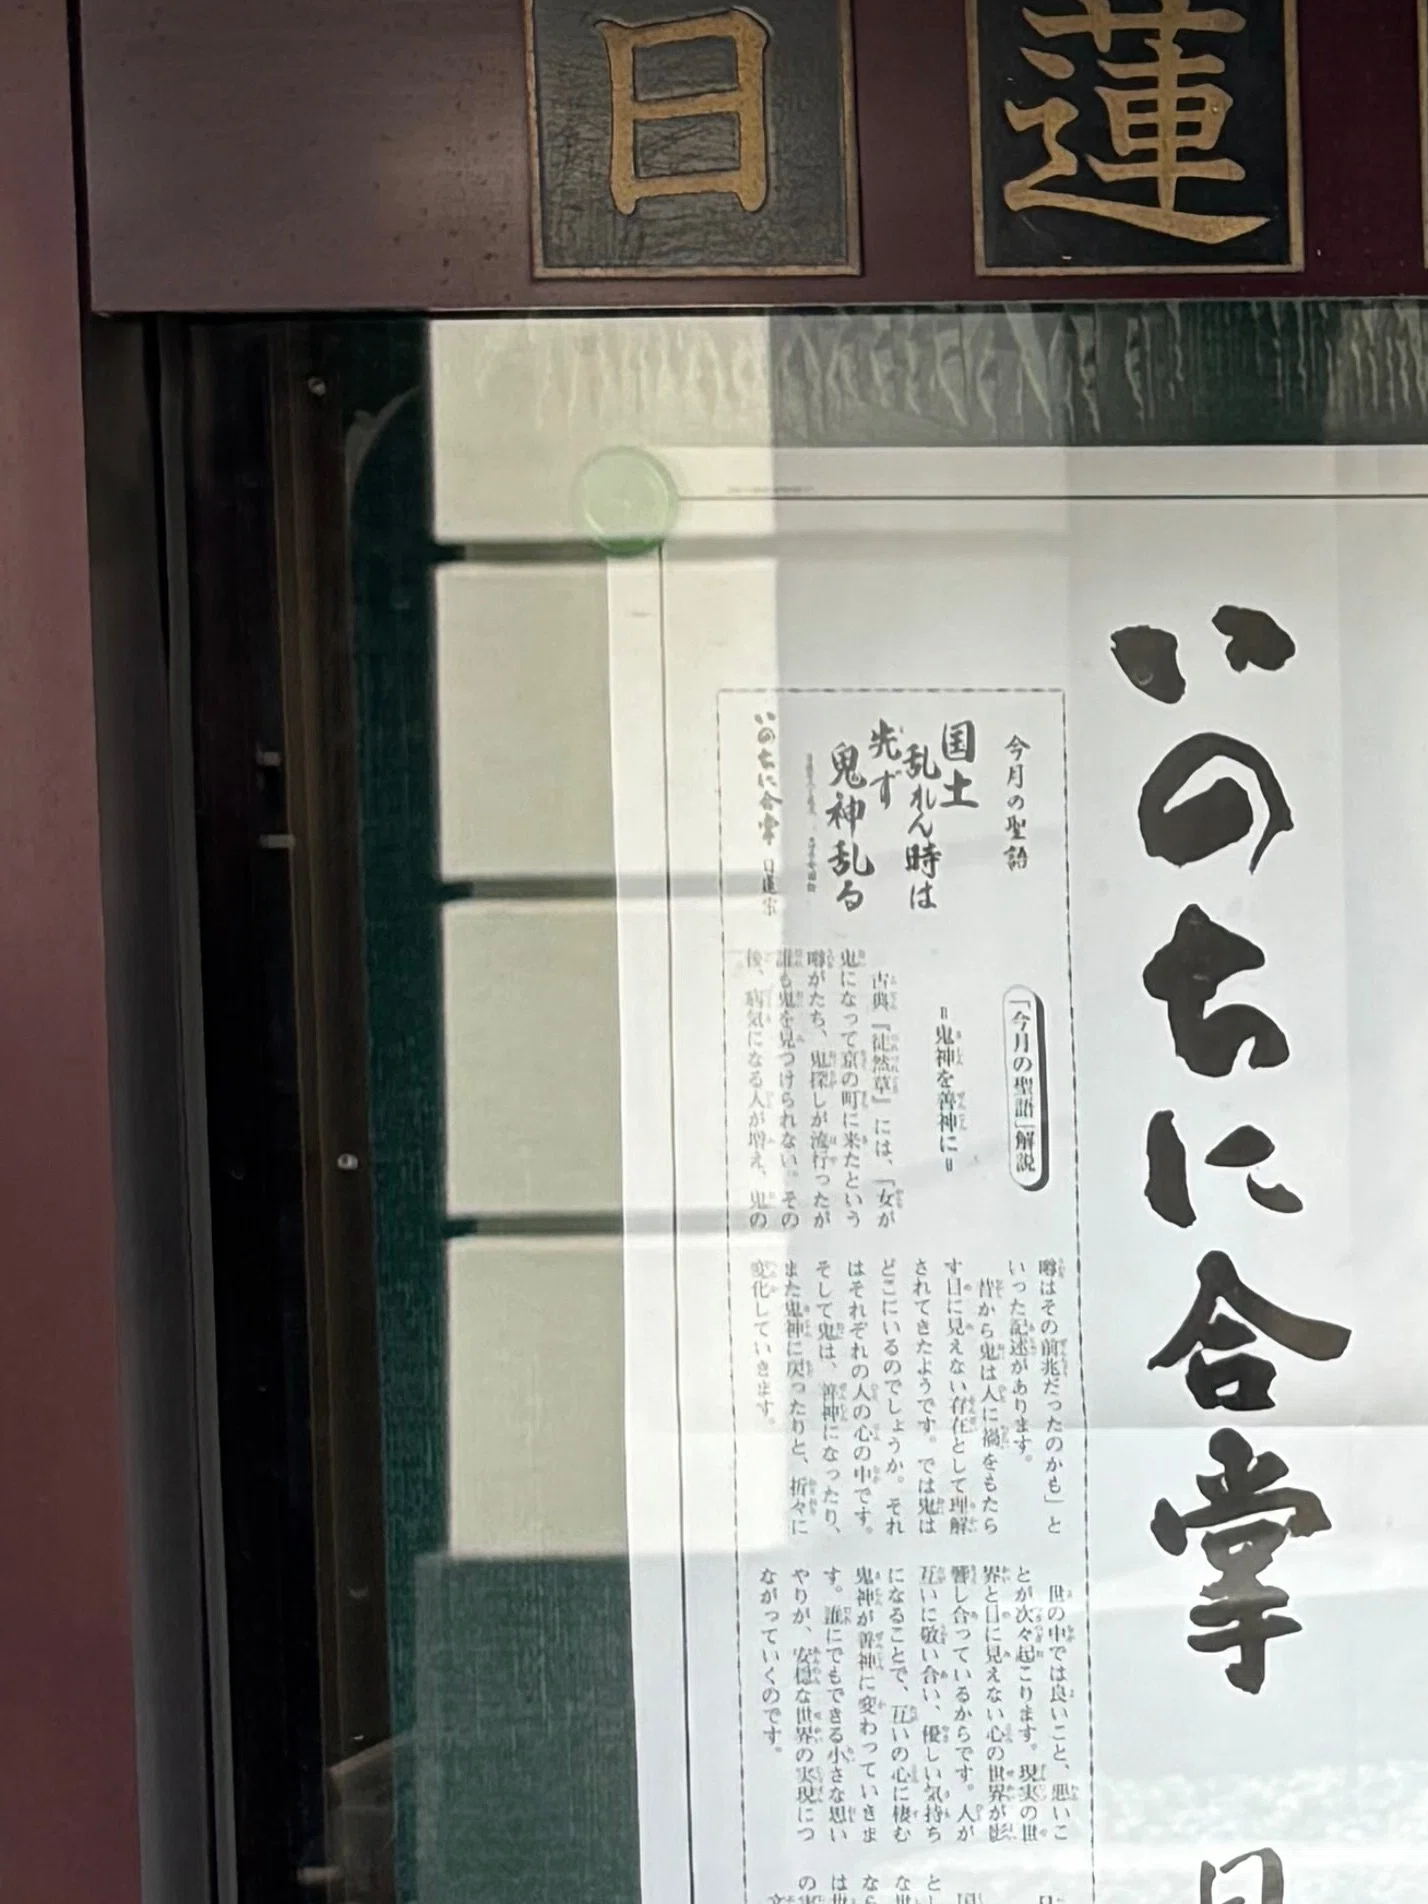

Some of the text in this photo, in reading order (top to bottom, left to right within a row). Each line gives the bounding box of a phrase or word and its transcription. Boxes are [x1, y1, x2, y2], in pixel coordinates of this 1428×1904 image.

[940, 720, 979, 808] 国土
[1110, 605, 1352, 1695] いのちに合掌
